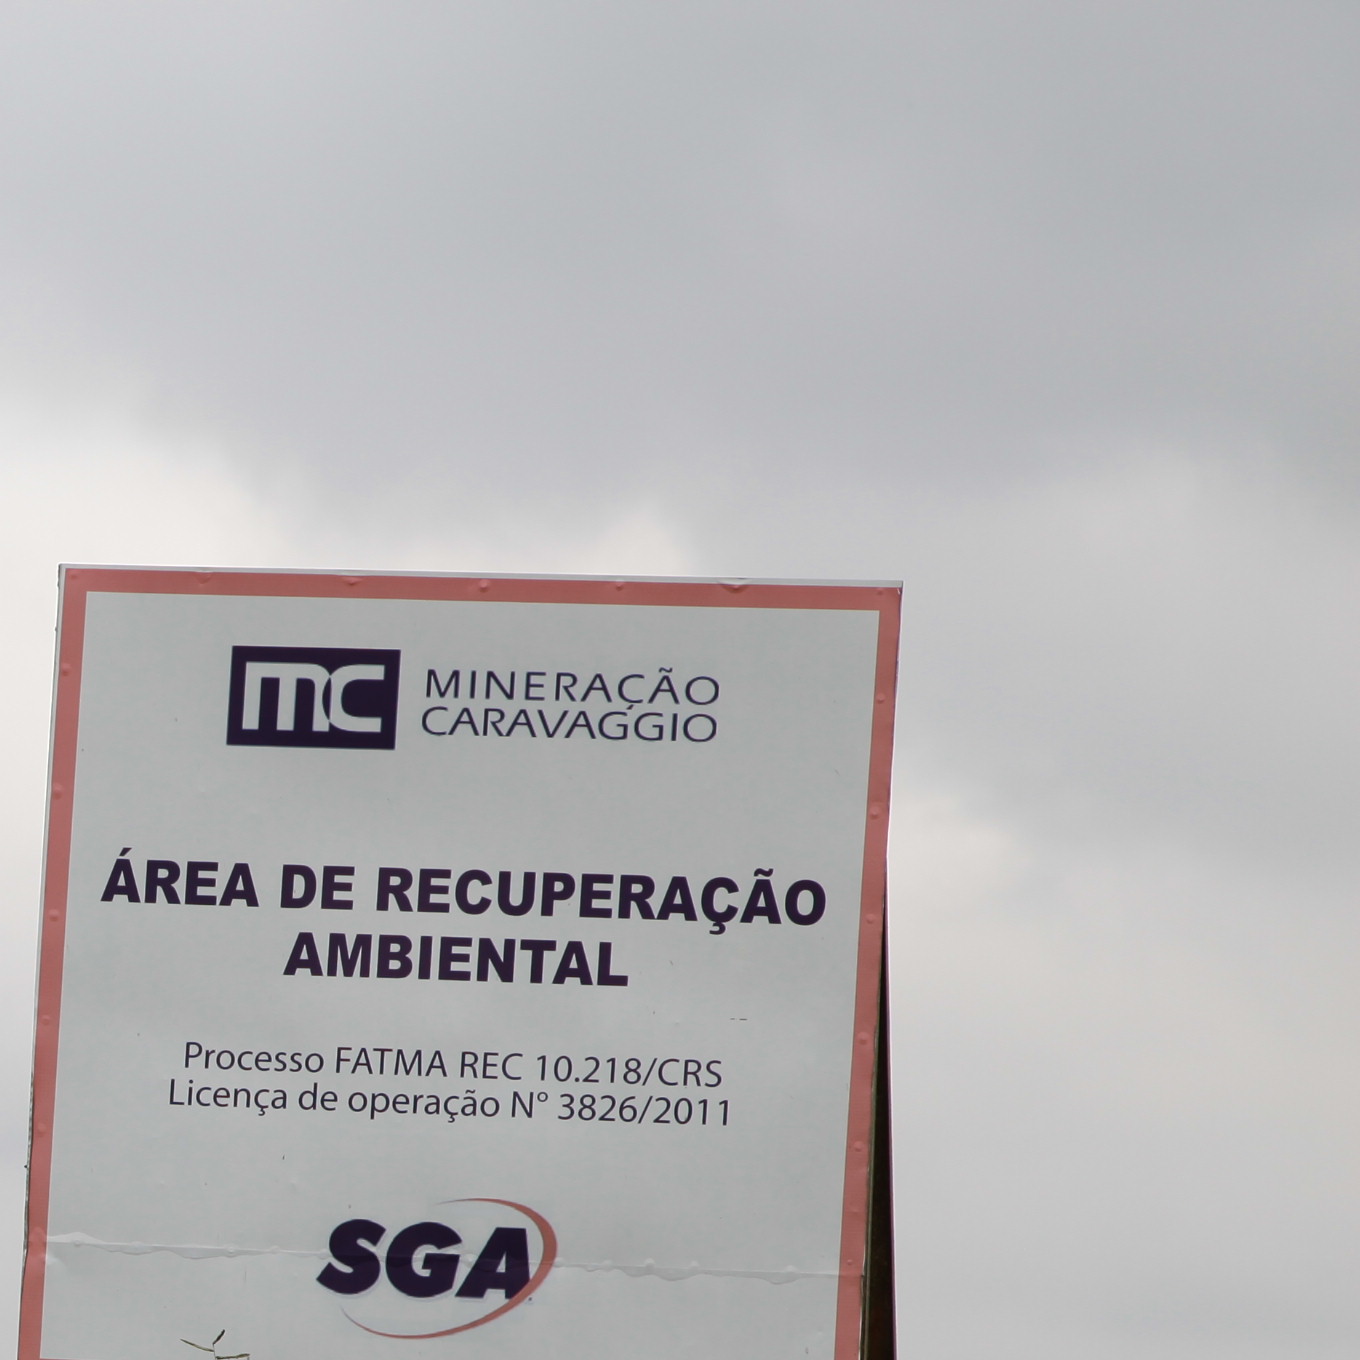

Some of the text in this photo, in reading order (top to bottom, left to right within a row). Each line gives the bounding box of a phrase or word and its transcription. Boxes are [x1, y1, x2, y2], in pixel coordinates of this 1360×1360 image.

[425, 667, 720, 710] MINERAÇÃO
[421, 706, 718, 744] CARAVAGGIO
[99, 846, 827, 936] ÁREA DE RECUPERAÇÃO
[282, 931, 629, 987] AMBIENTAL
[184, 1041, 723, 1088] Processo FATMA REC 10.218/CRS
[169, 1078, 288, 1117] Licença
[298, 1082, 339, 1112] de
[347, 1089, 501, 1124] operação
[557, 1093, 730, 1127] 3826/2011
[315, 1218, 532, 1300] SGA
